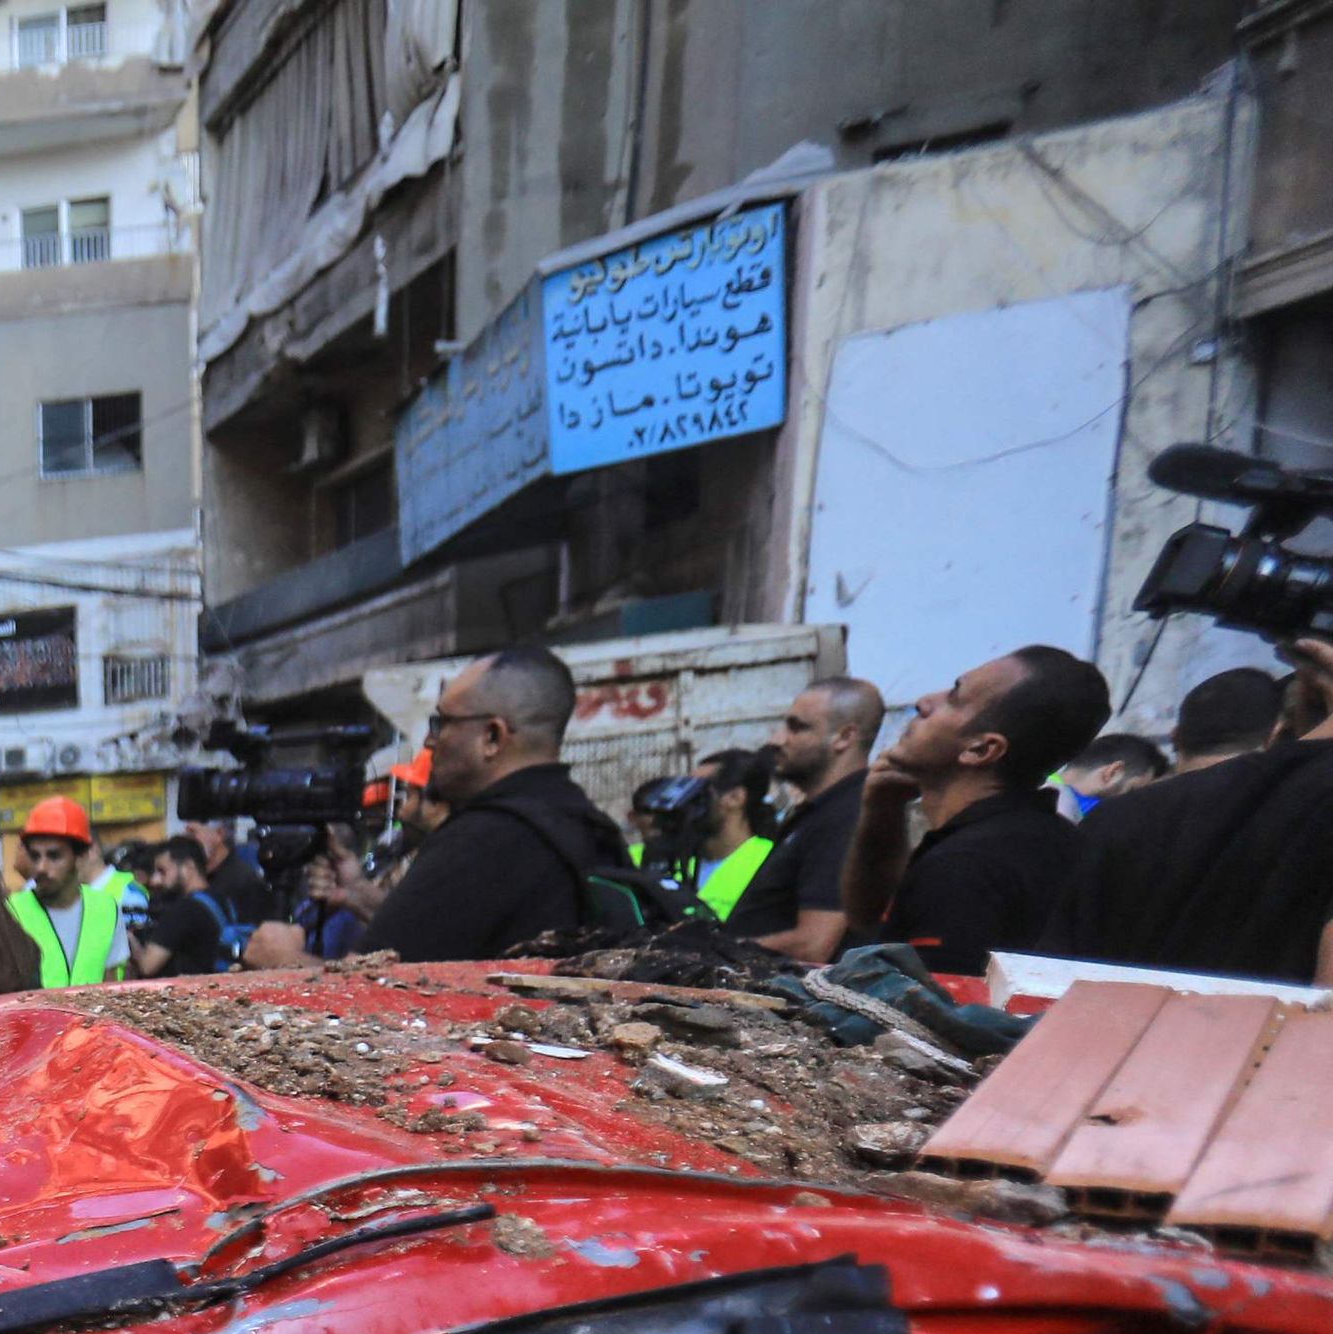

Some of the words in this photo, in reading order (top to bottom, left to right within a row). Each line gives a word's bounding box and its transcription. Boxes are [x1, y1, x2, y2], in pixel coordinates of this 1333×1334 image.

[638, 283, 721, 323] سيارات
[722, 260, 773, 310] قطع
[552, 301, 634, 350] يابانية
